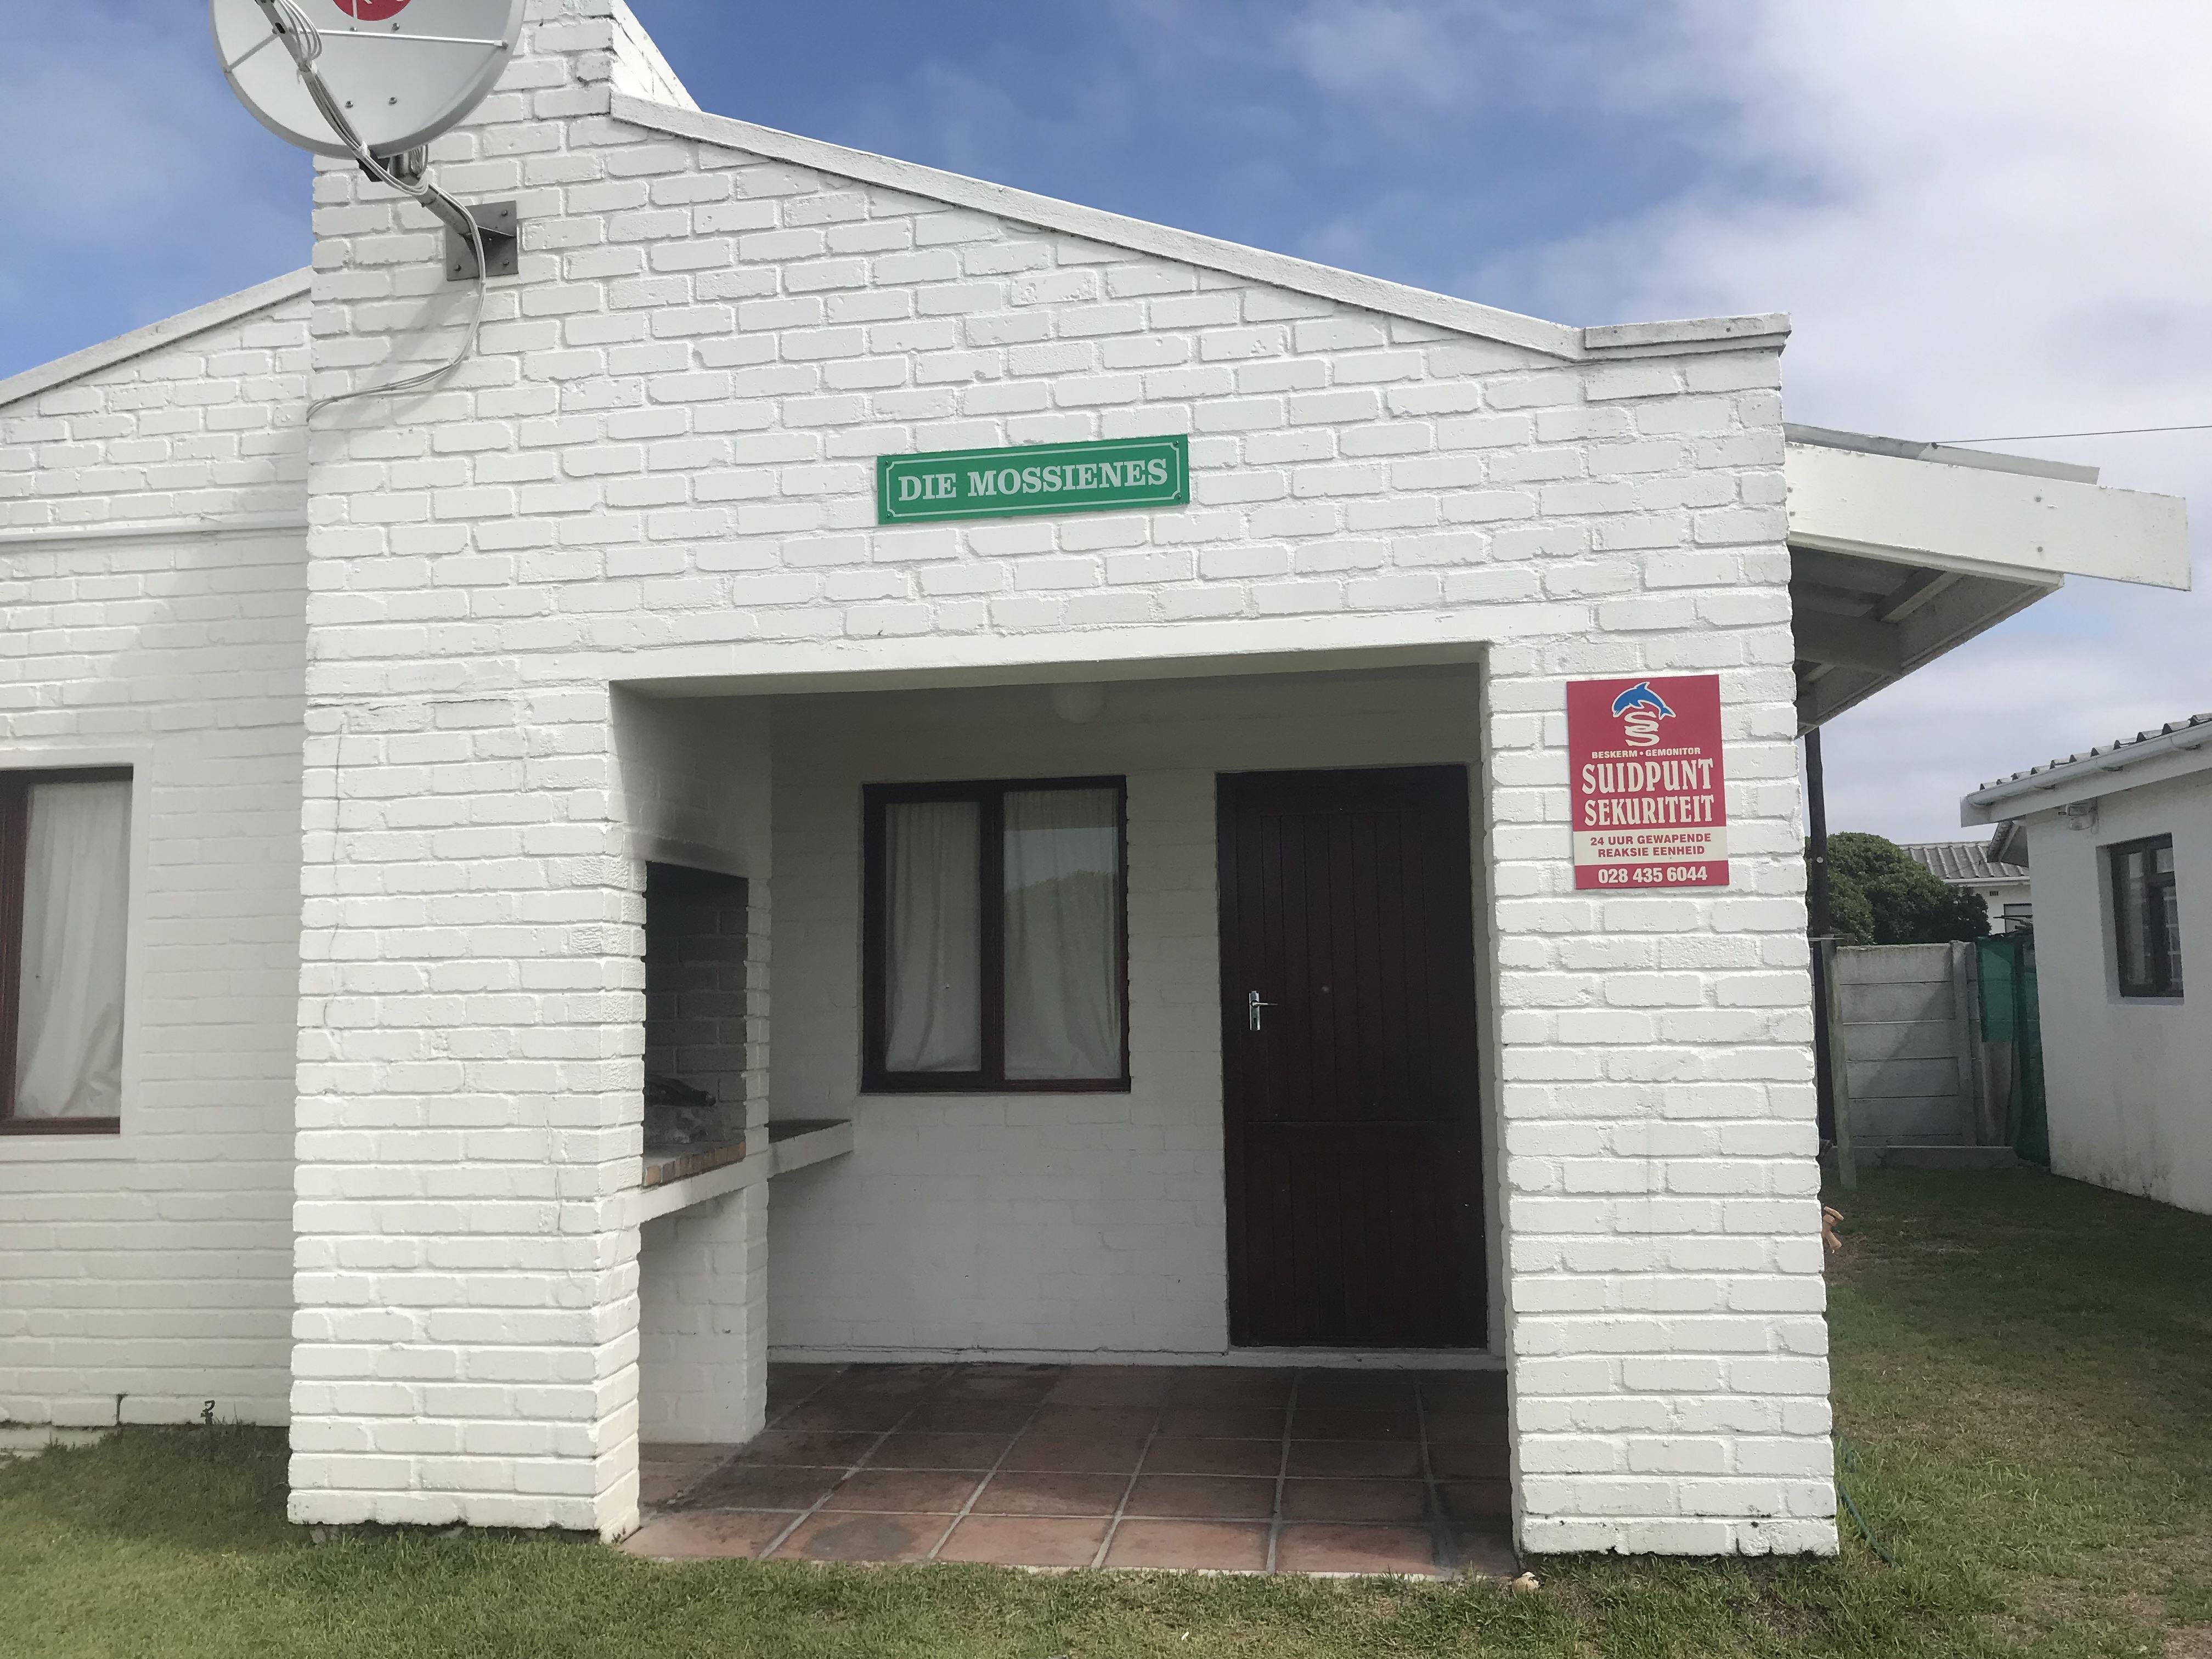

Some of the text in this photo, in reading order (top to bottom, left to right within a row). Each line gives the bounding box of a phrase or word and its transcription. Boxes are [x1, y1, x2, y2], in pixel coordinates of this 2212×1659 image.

[898, 458, 1167, 501] DIE MOSSIENES
[1592, 747, 1701, 759] BESKERM GEMONITOR
[1582, 758, 1713, 794] SUIDPUNT
[1584, 794, 1714, 826] SEKURITEIT
[1590, 833, 1711, 846] 24 UUR GEWAPENDE
[1598, 845, 1705, 857] REAKSIE EENHEID
[1598, 866, 1707, 884] 028 435 6044
